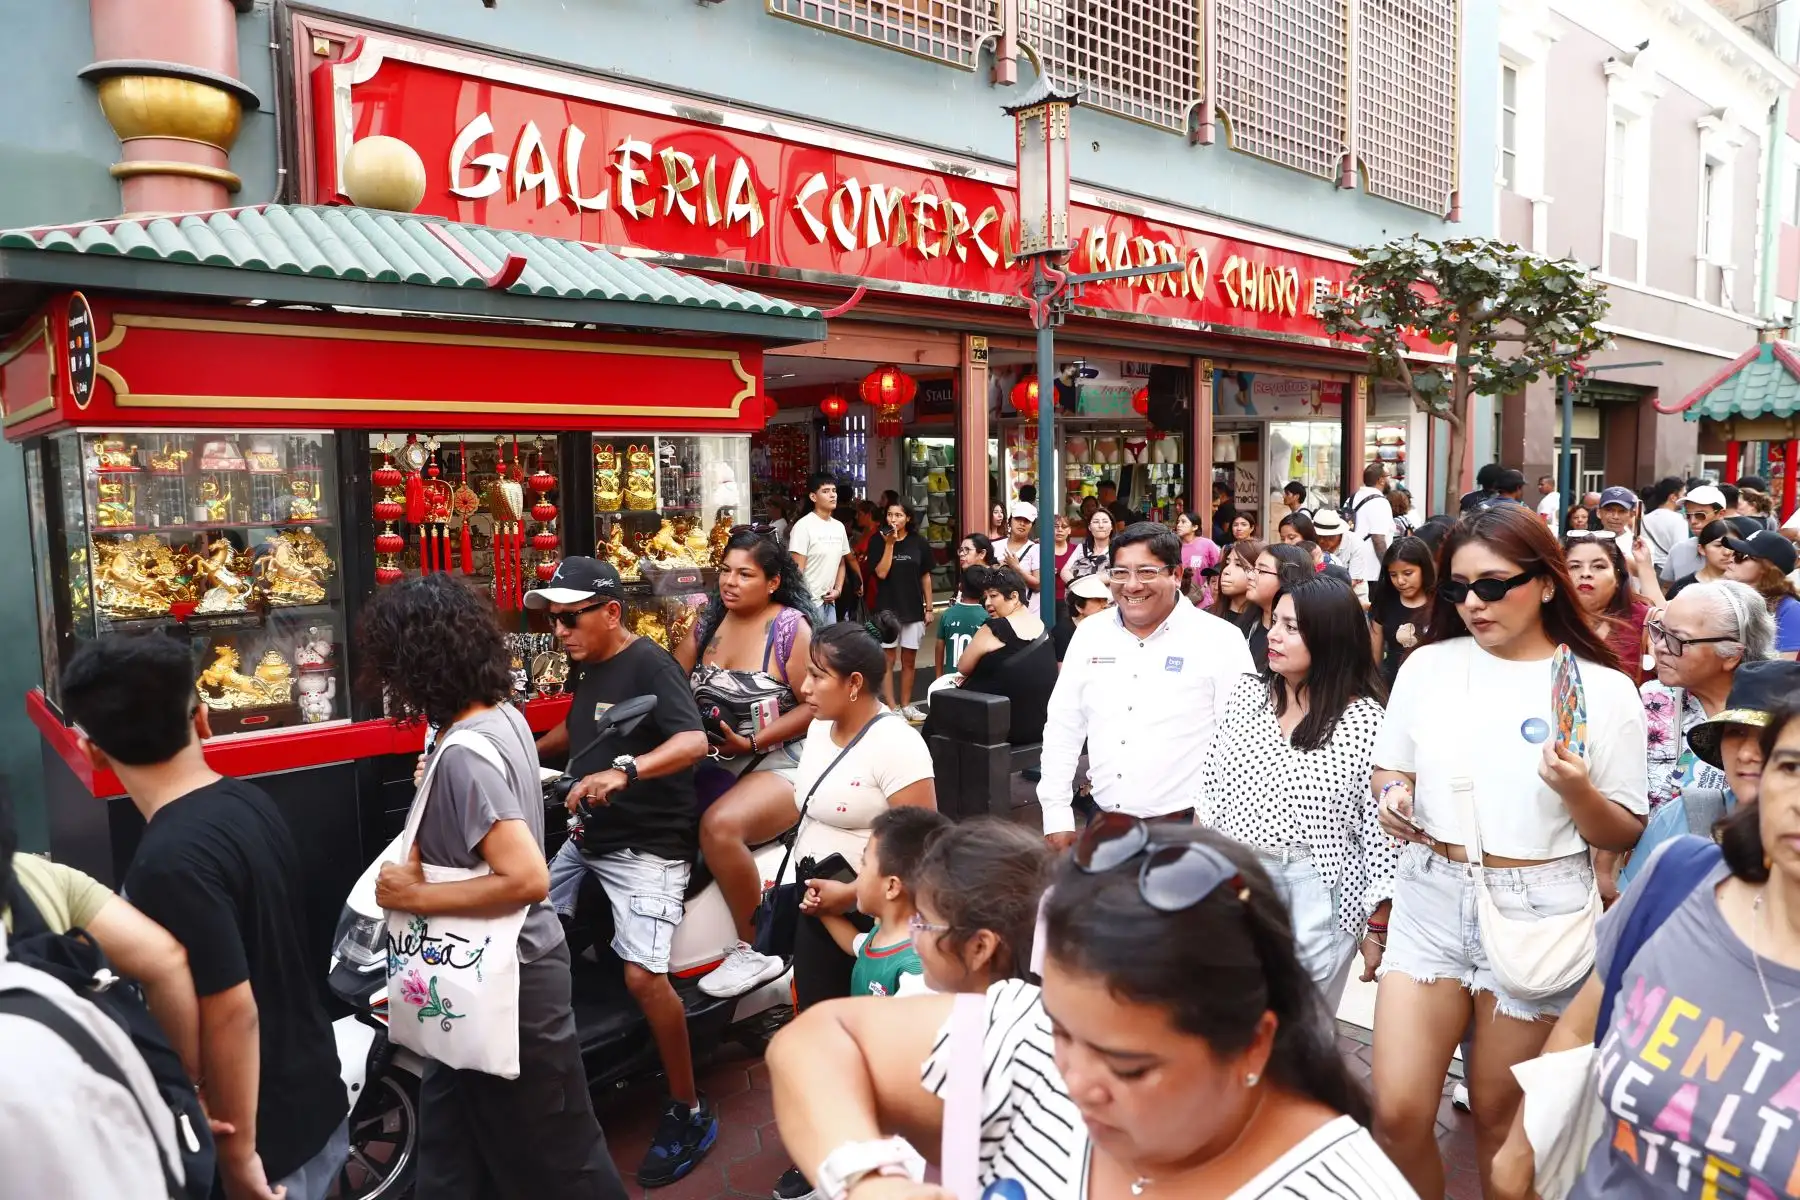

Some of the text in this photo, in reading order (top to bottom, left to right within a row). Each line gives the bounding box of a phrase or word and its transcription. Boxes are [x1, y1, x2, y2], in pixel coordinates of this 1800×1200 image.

[448, 111, 765, 238] GALERIA
[1219, 254, 1300, 318] CHINO
[973, 348, 988, 360] 738
[1594, 1031, 1800, 1197] HEALT
